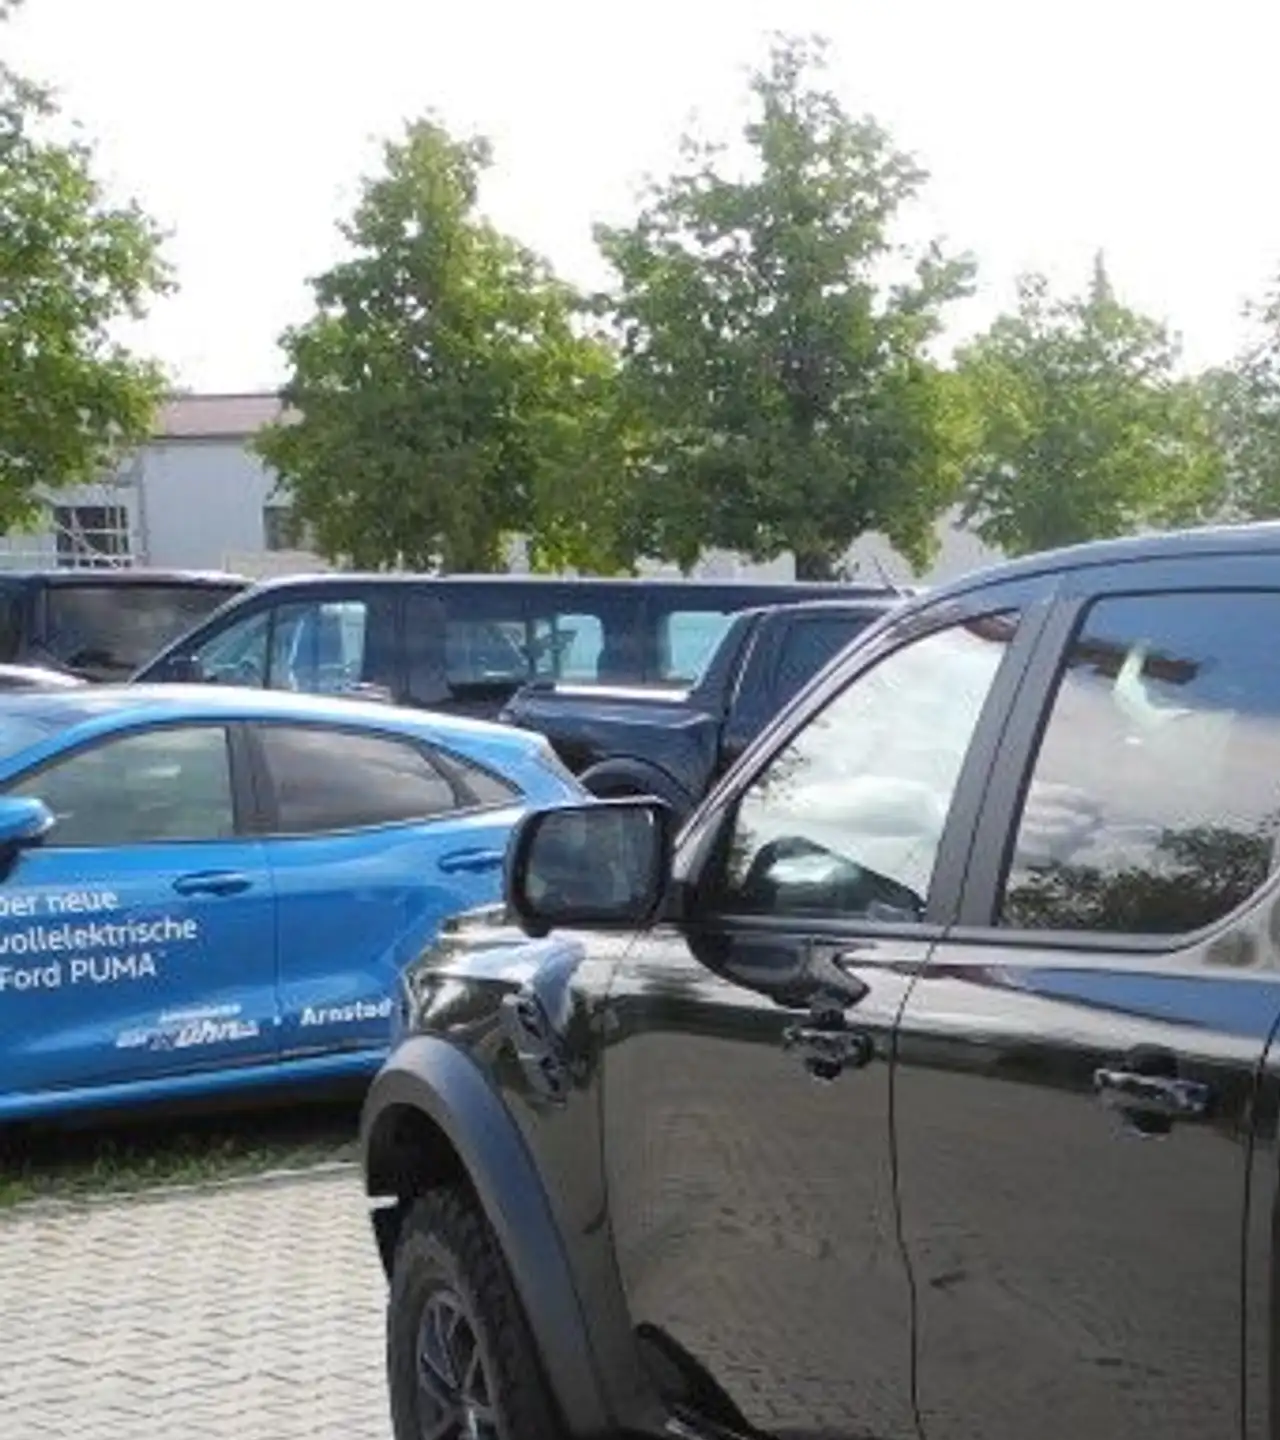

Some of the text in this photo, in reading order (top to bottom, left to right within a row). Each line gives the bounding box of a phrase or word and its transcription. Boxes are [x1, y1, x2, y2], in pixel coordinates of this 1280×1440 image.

[46, 890, 120, 912] neue
[0, 951, 156, 992] Ford PUMA
